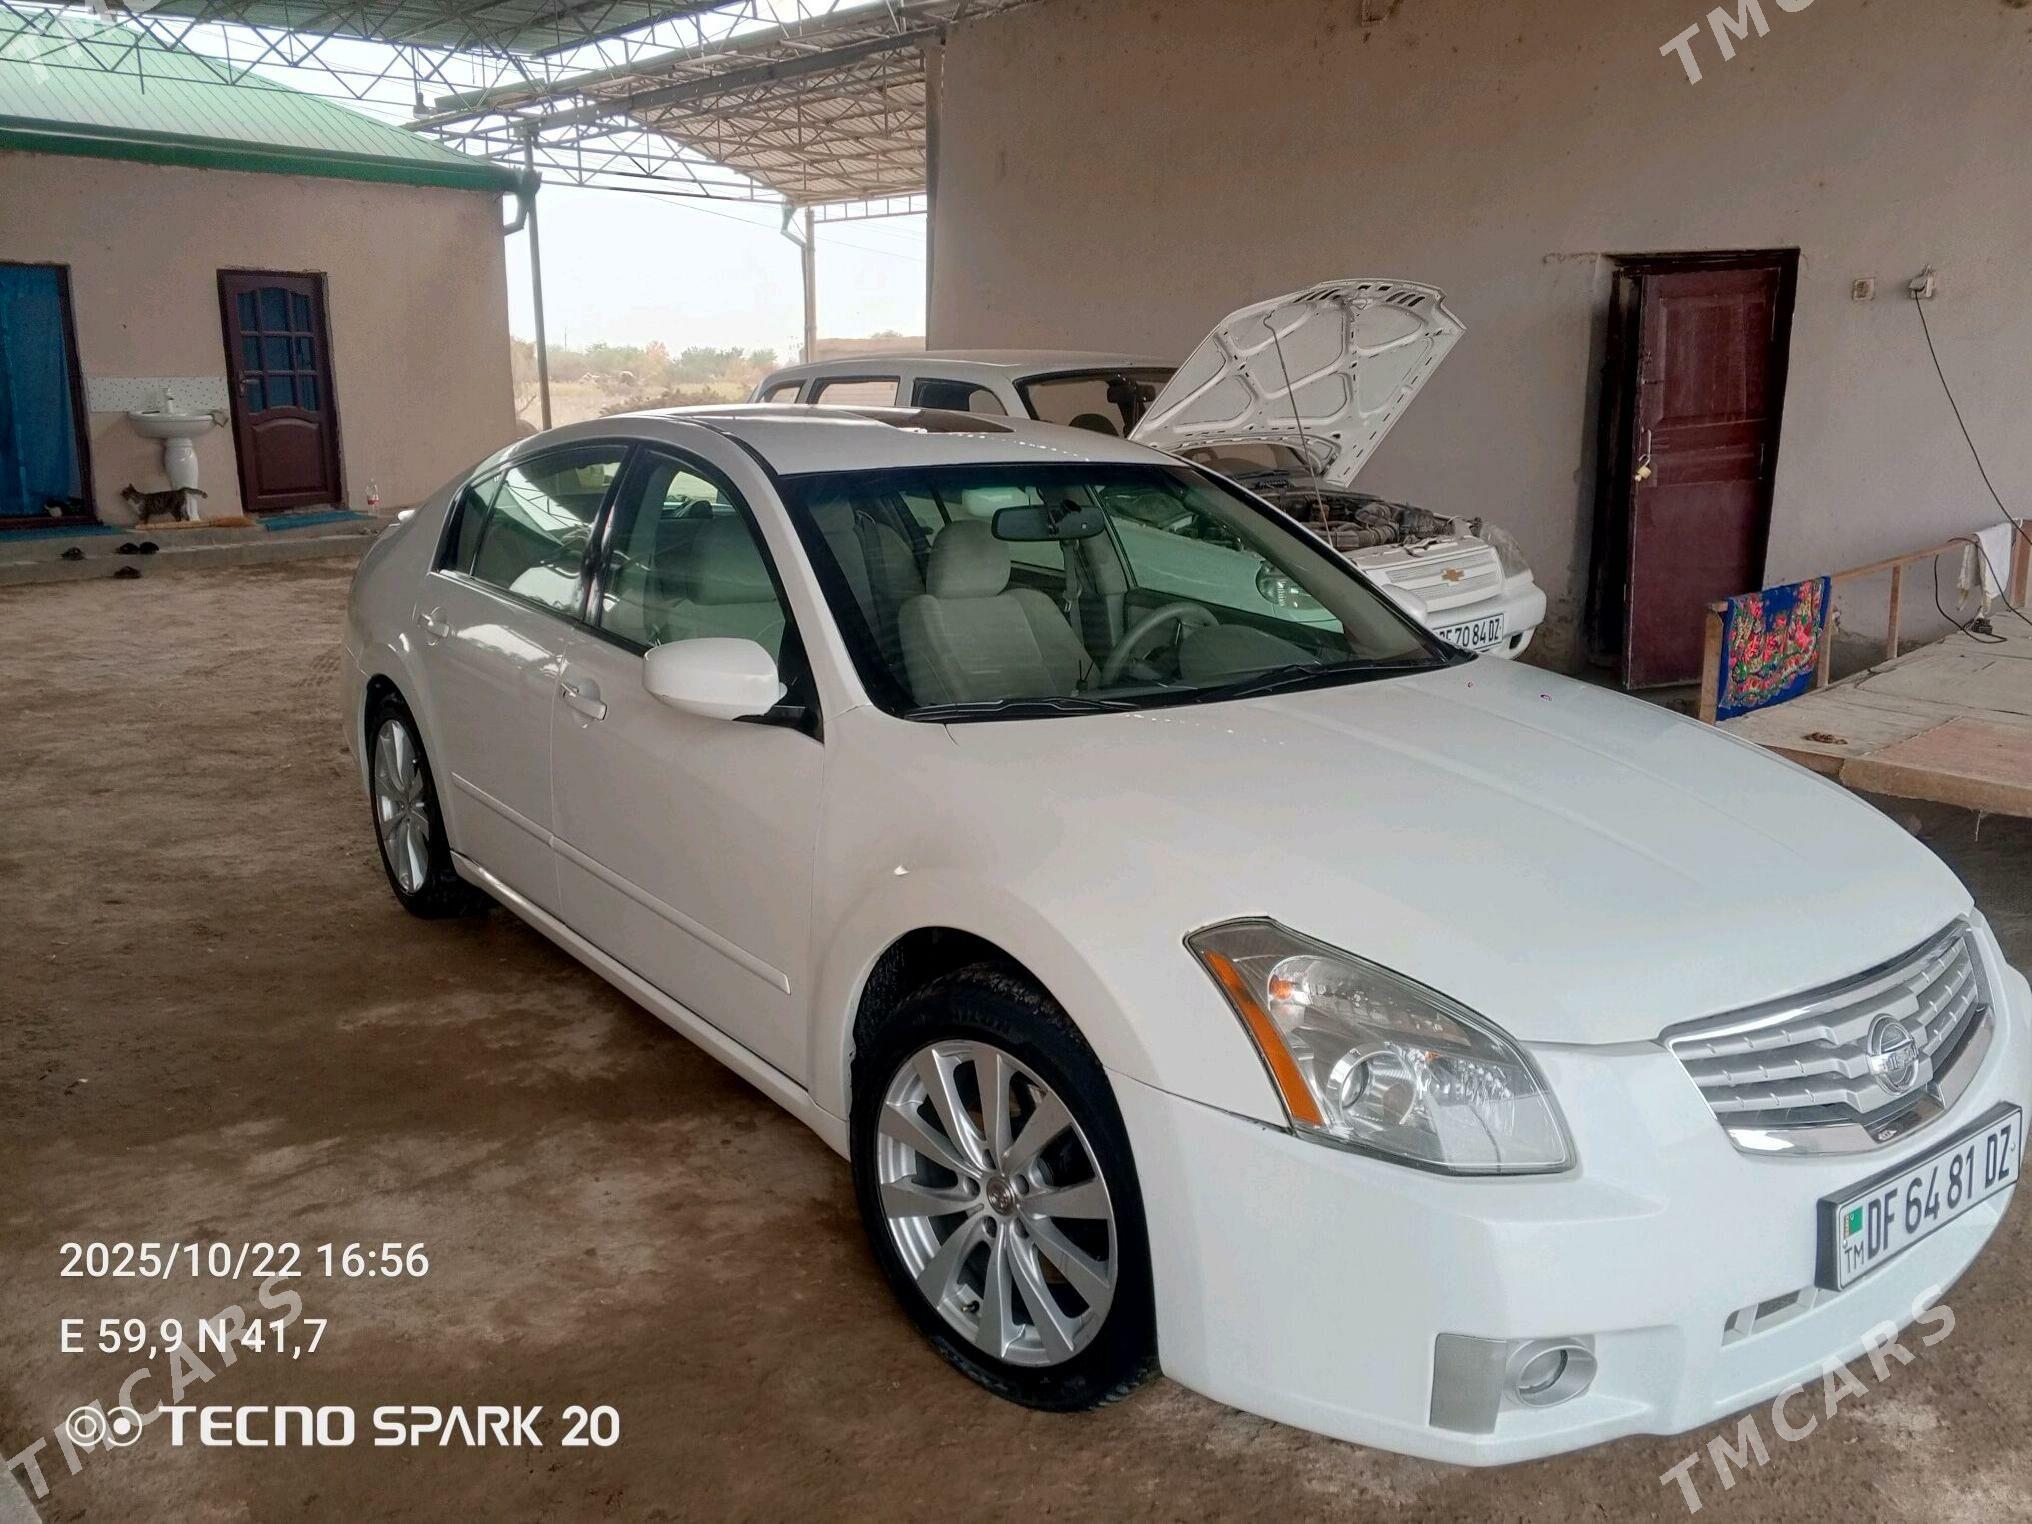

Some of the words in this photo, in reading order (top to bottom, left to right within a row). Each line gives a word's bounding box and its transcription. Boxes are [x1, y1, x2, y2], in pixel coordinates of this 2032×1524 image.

[1454, 626, 1471, 648] 70
[1472, 622, 1487, 645] 84
[1488, 618, 1500, 642] DZ
[1867, 1188, 1898, 1260] DF
[1905, 1166, 1940, 1234] 64
[1947, 1144, 1975, 1209] 81
[1985, 1124, 2012, 1189] DZ
[1844, 1240, 1865, 1273] TM
